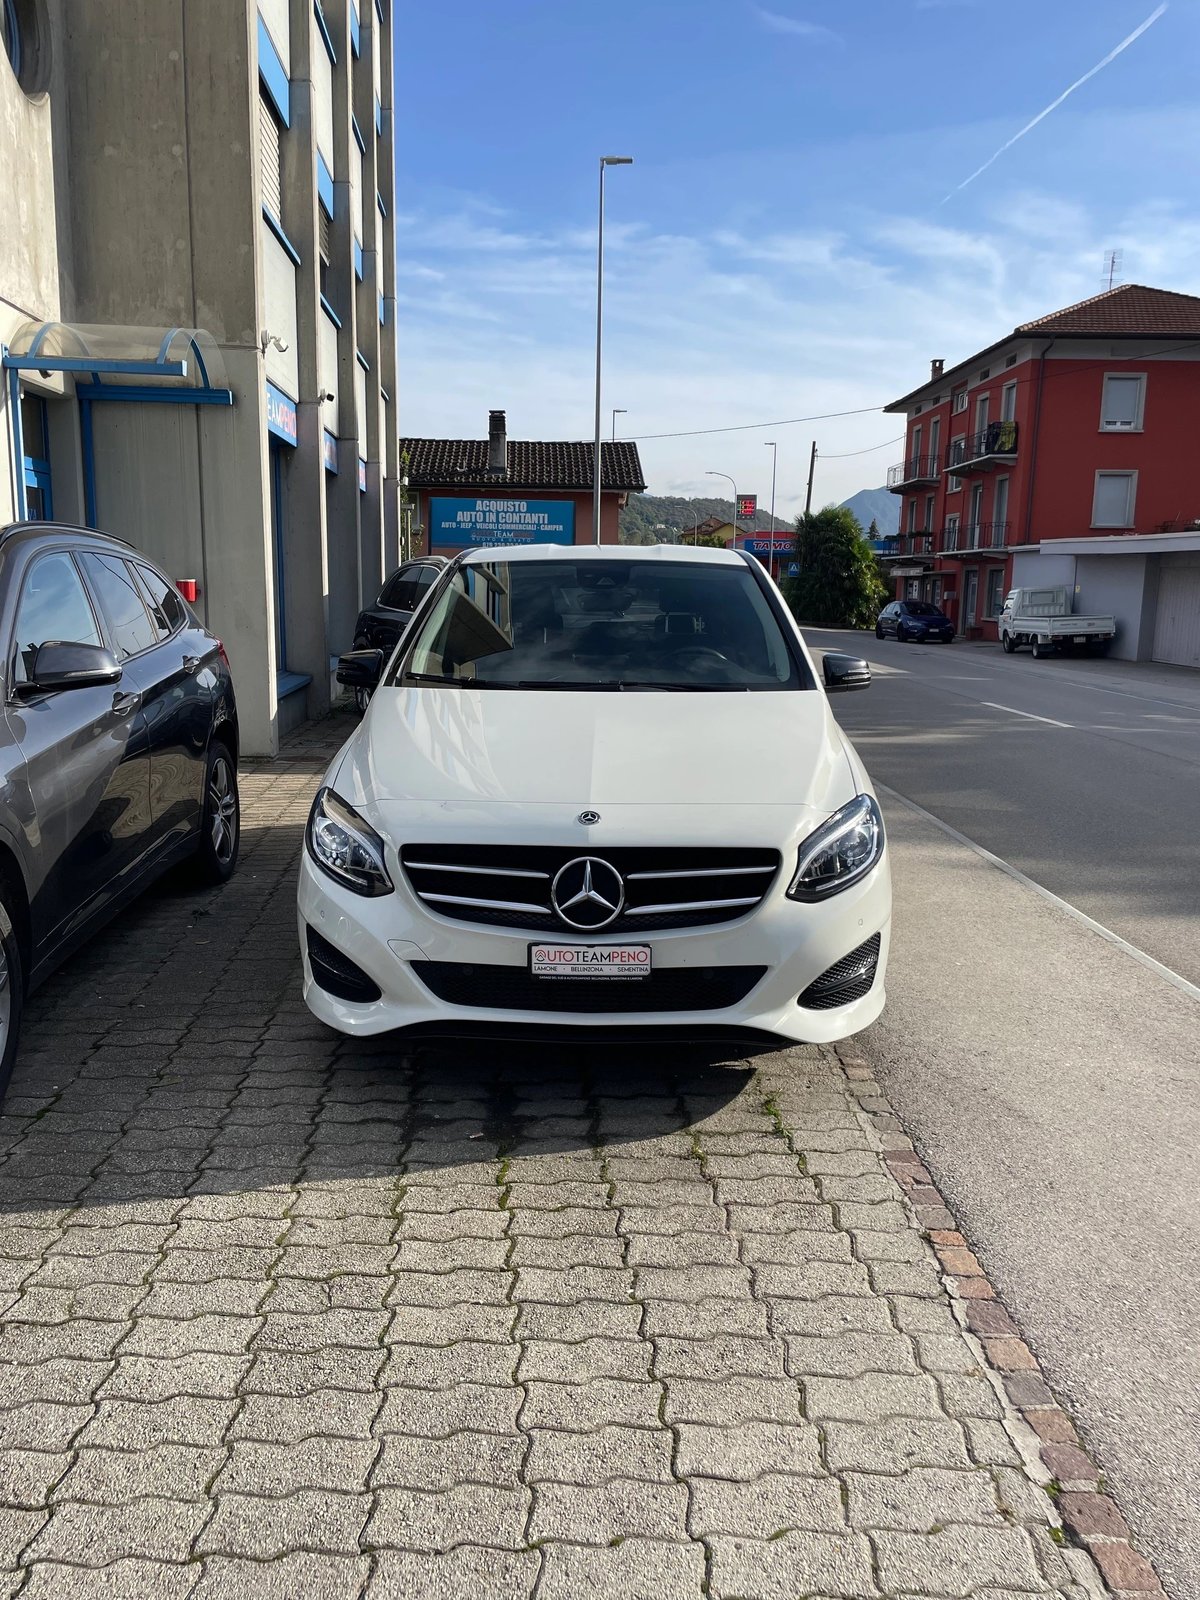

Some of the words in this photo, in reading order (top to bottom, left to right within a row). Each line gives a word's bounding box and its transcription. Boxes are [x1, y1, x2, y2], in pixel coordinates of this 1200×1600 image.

[475, 500, 527, 512] ACQUISTO
[456, 511, 483, 522] AUTO
[486, 512, 497, 522] IN
[499, 512, 548, 524] CONTANTI
